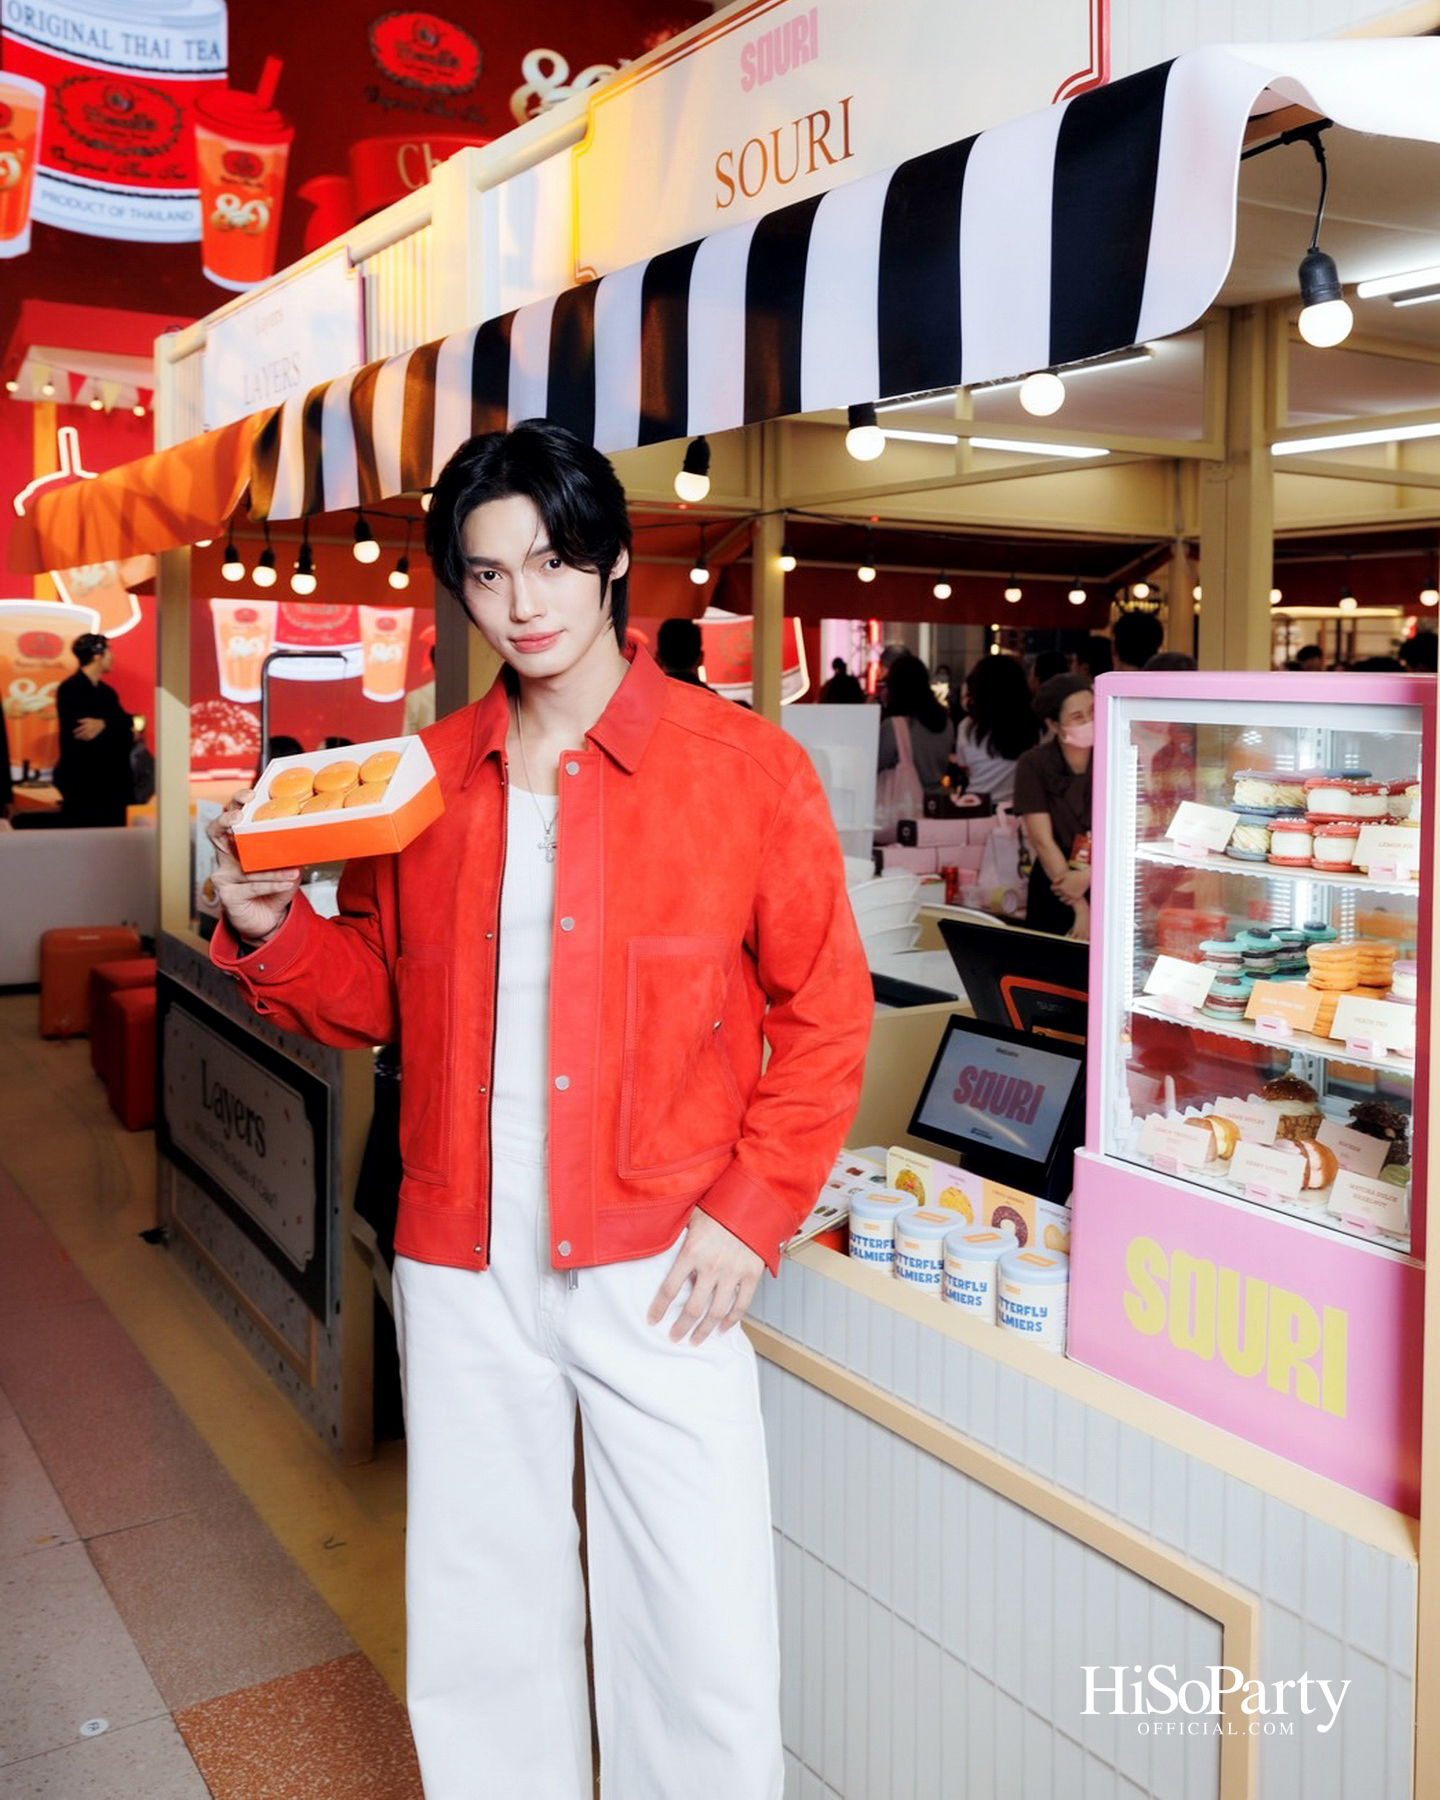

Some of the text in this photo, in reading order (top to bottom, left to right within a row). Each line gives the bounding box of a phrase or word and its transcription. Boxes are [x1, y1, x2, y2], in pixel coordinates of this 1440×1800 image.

[7, 0, 222, 61] ORIGINAL THAI TEA
[740, 7, 819, 94] SOURI
[715, 95, 855, 210] SOURI
[40, 188, 196, 223] PRODUCT OF THAILAND
[243, 351, 301, 405] LAYERS
[200, 1057, 267, 1158] Layers
[952, 1064, 1046, 1127] SOURI
[1123, 1236, 1349, 1419] SOURI
